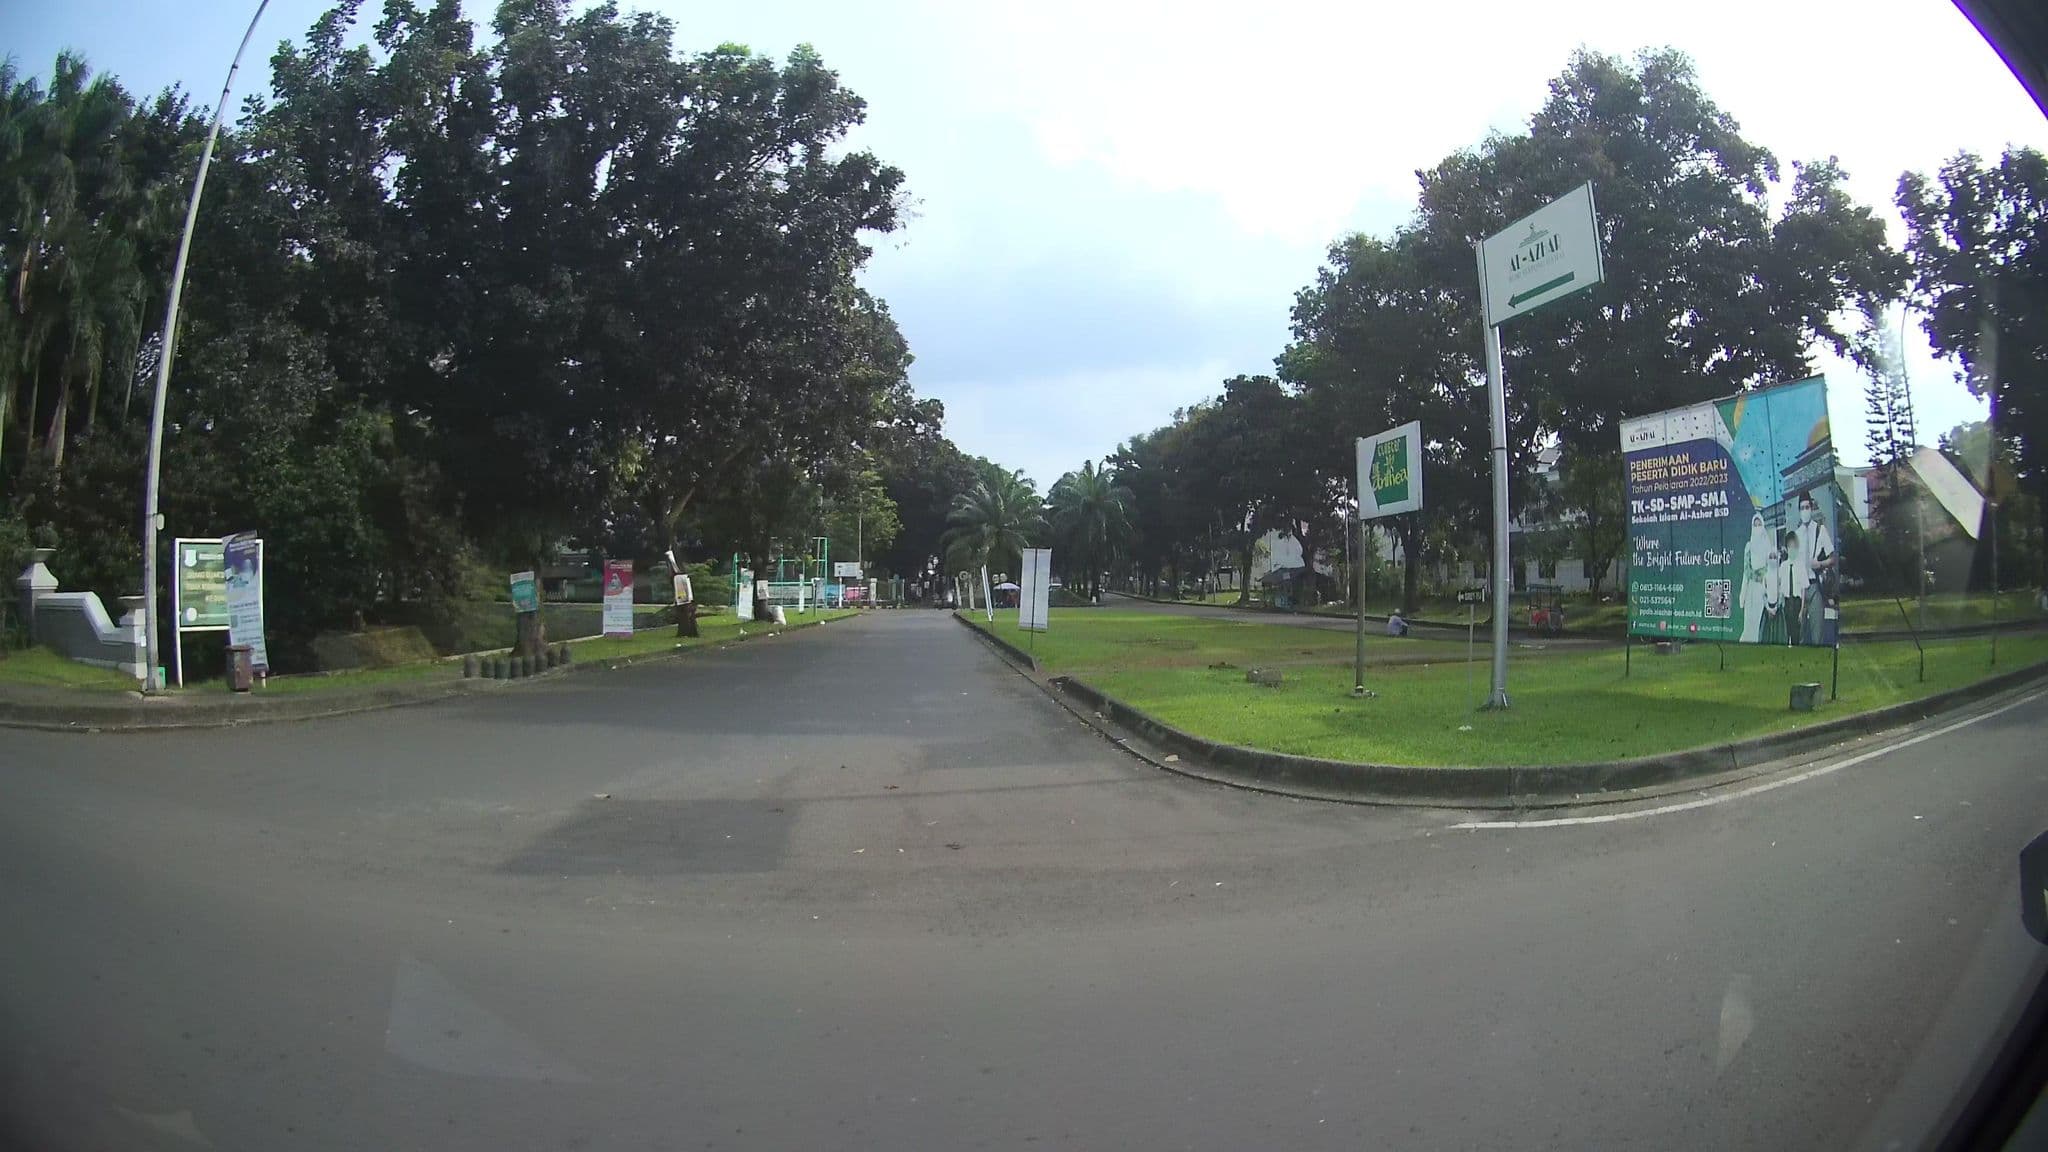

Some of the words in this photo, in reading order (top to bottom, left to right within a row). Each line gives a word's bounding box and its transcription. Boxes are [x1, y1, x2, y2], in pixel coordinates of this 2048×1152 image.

[1630, 452, 1689, 471] PENERIMAAN
[1631, 467, 1669, 482] PESERTA
[1671, 462, 1698, 476] DIDIK
[1700, 458, 1727, 473] BARU
[1631, 484, 1653, 494] Tahun
[1690, 473, 1728, 487] 2022/2023
[1631, 490, 1728, 514] TK-SD-SMP-SMA
[1631, 513, 1658, 524] Sekolah
[1659, 511, 1678, 522] Islam
[1680, 509, 1713, 520] Al-Azhar
[1714, 507, 1730, 518] BSD
[1646, 550, 1673, 572] Bright
[1675, 550, 1701, 567] Future
